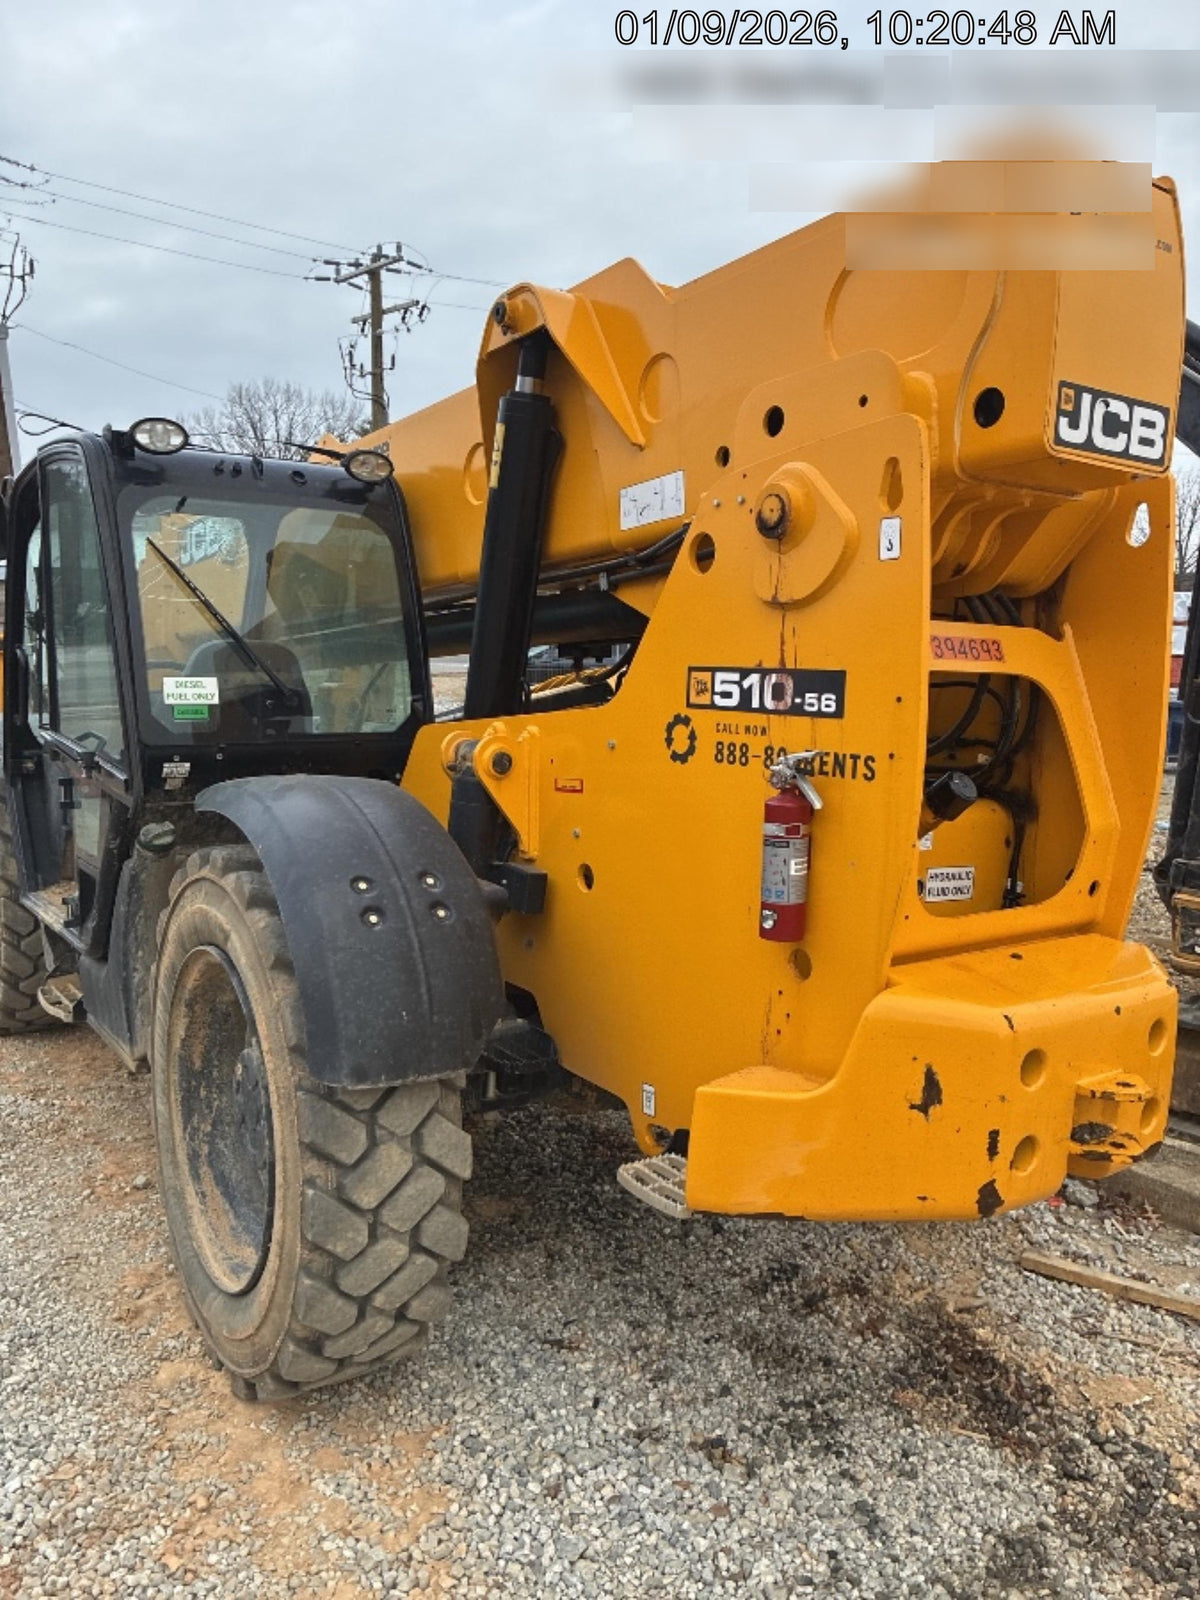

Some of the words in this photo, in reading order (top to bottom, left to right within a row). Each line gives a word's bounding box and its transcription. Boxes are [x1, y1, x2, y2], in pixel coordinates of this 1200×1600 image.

[1058, 391, 1165, 460] JCB
[931, 636, 1004, 661] 394693
[175, 680, 206, 689] DIESEL
[712, 670, 837, 712] 510-56
[166, 692, 190, 701] FUEL
[191, 692, 216, 701] ONLY
[715, 722, 740, 735] CALL
[744, 725, 767, 737] NOW
[927, 886, 950, 898] FLUID
[951, 884, 972, 897] ONLY
